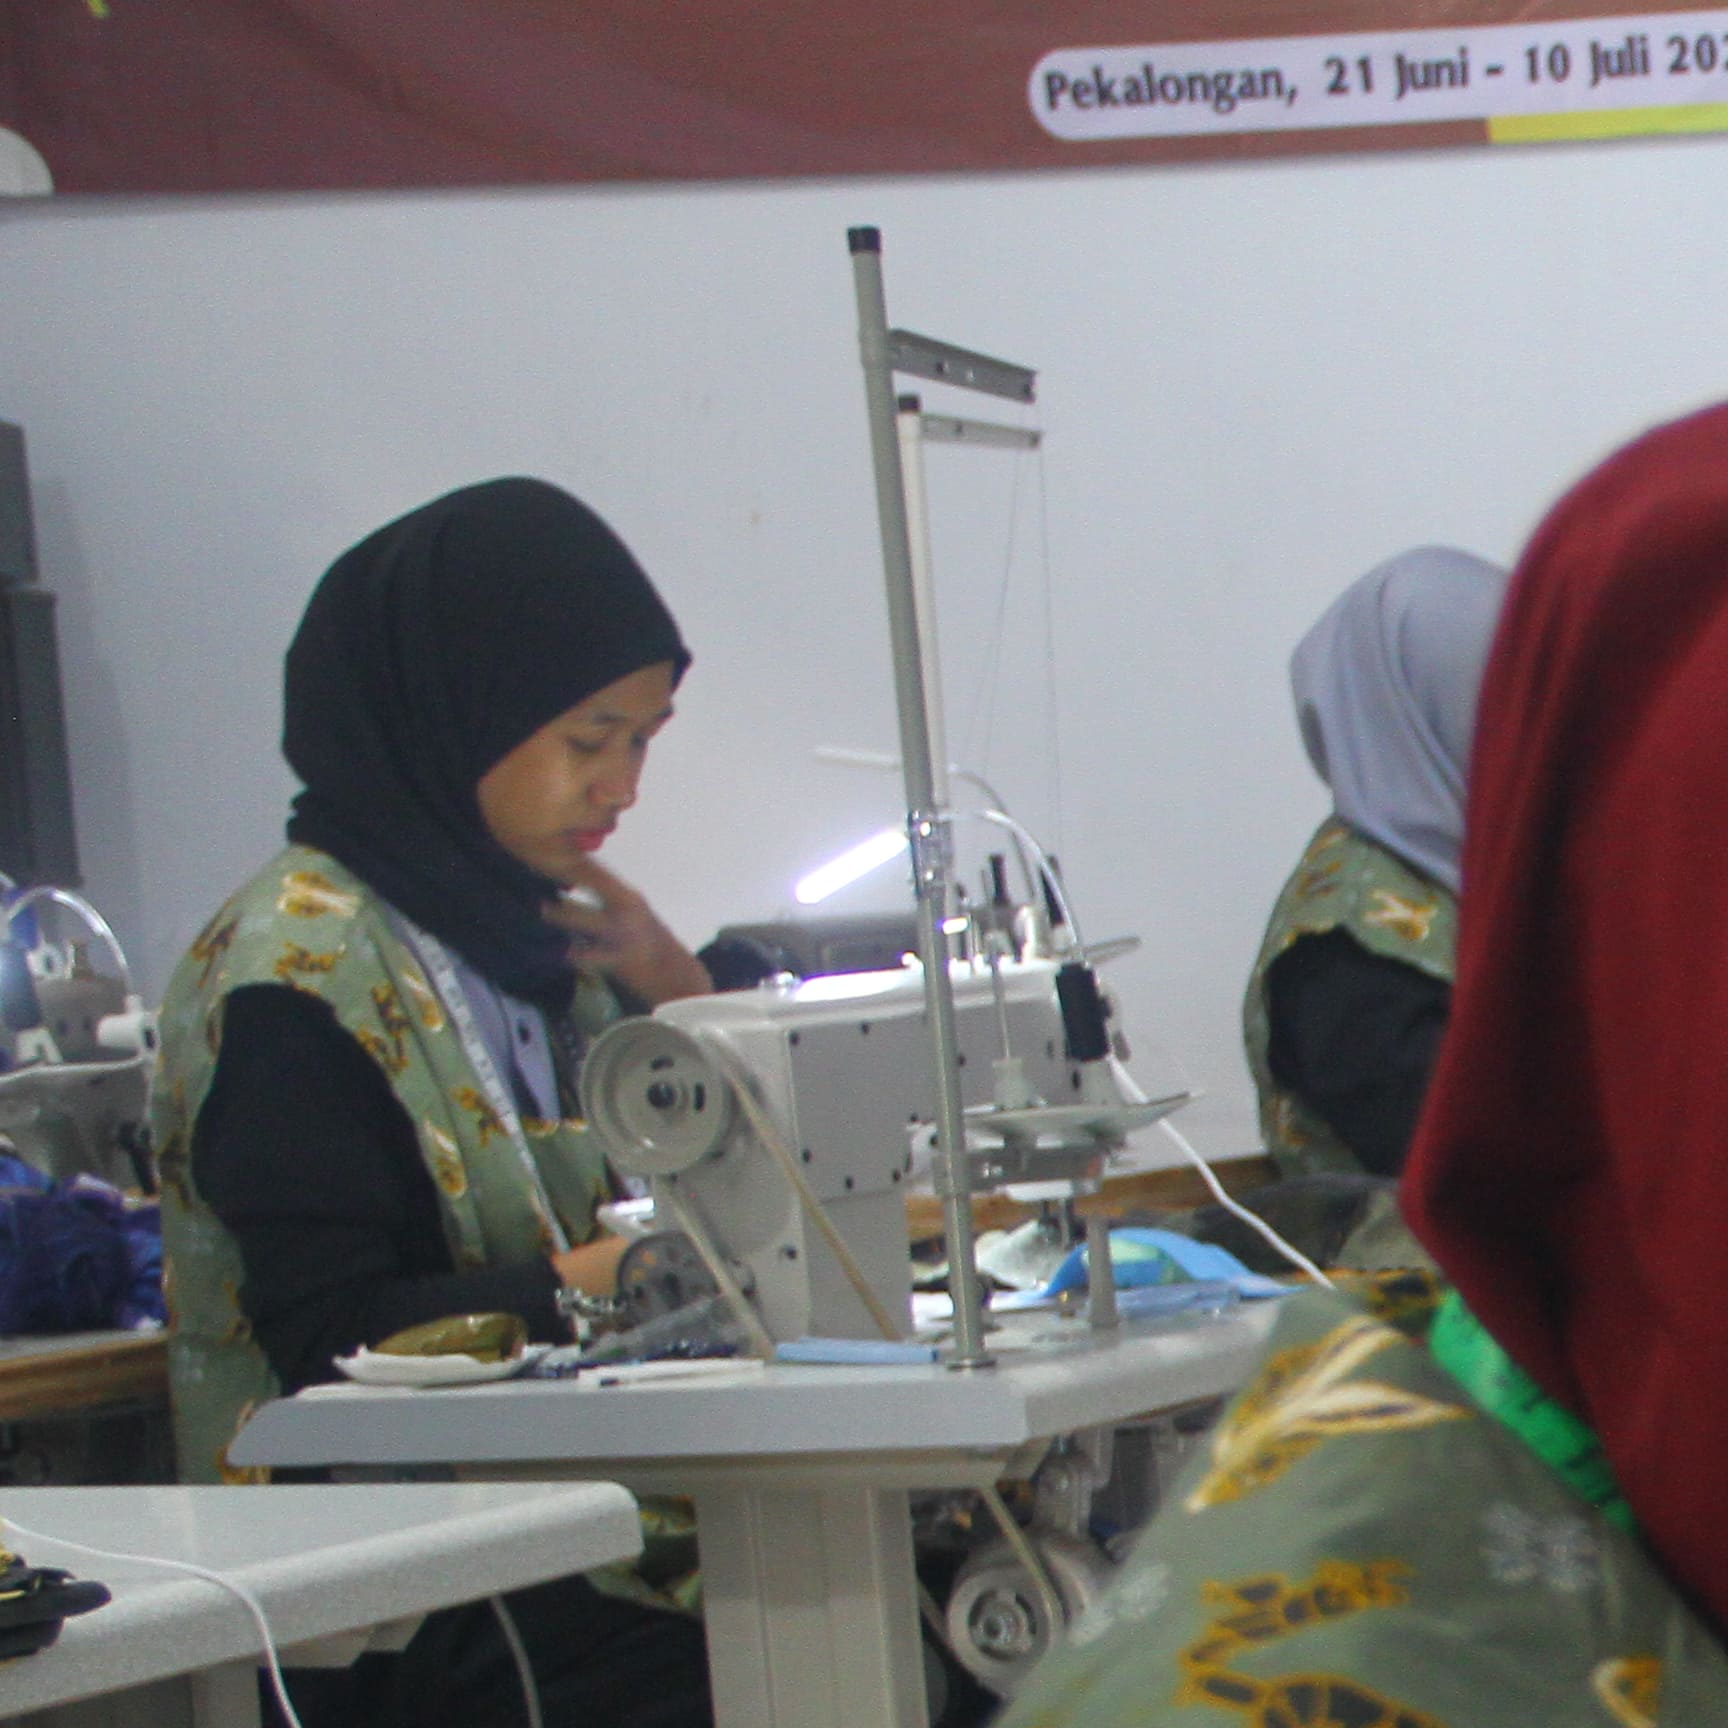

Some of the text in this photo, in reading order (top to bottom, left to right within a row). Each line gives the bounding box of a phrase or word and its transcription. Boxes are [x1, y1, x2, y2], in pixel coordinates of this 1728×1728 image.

[1045, 62, 1297, 114] Pekalongan,
[1324, 54, 1373, 96] 21
[1394, 46, 1469, 100] Juni
[1525, 45, 1571, 83] 10
[1590, 34, 1650, 87] Juli
